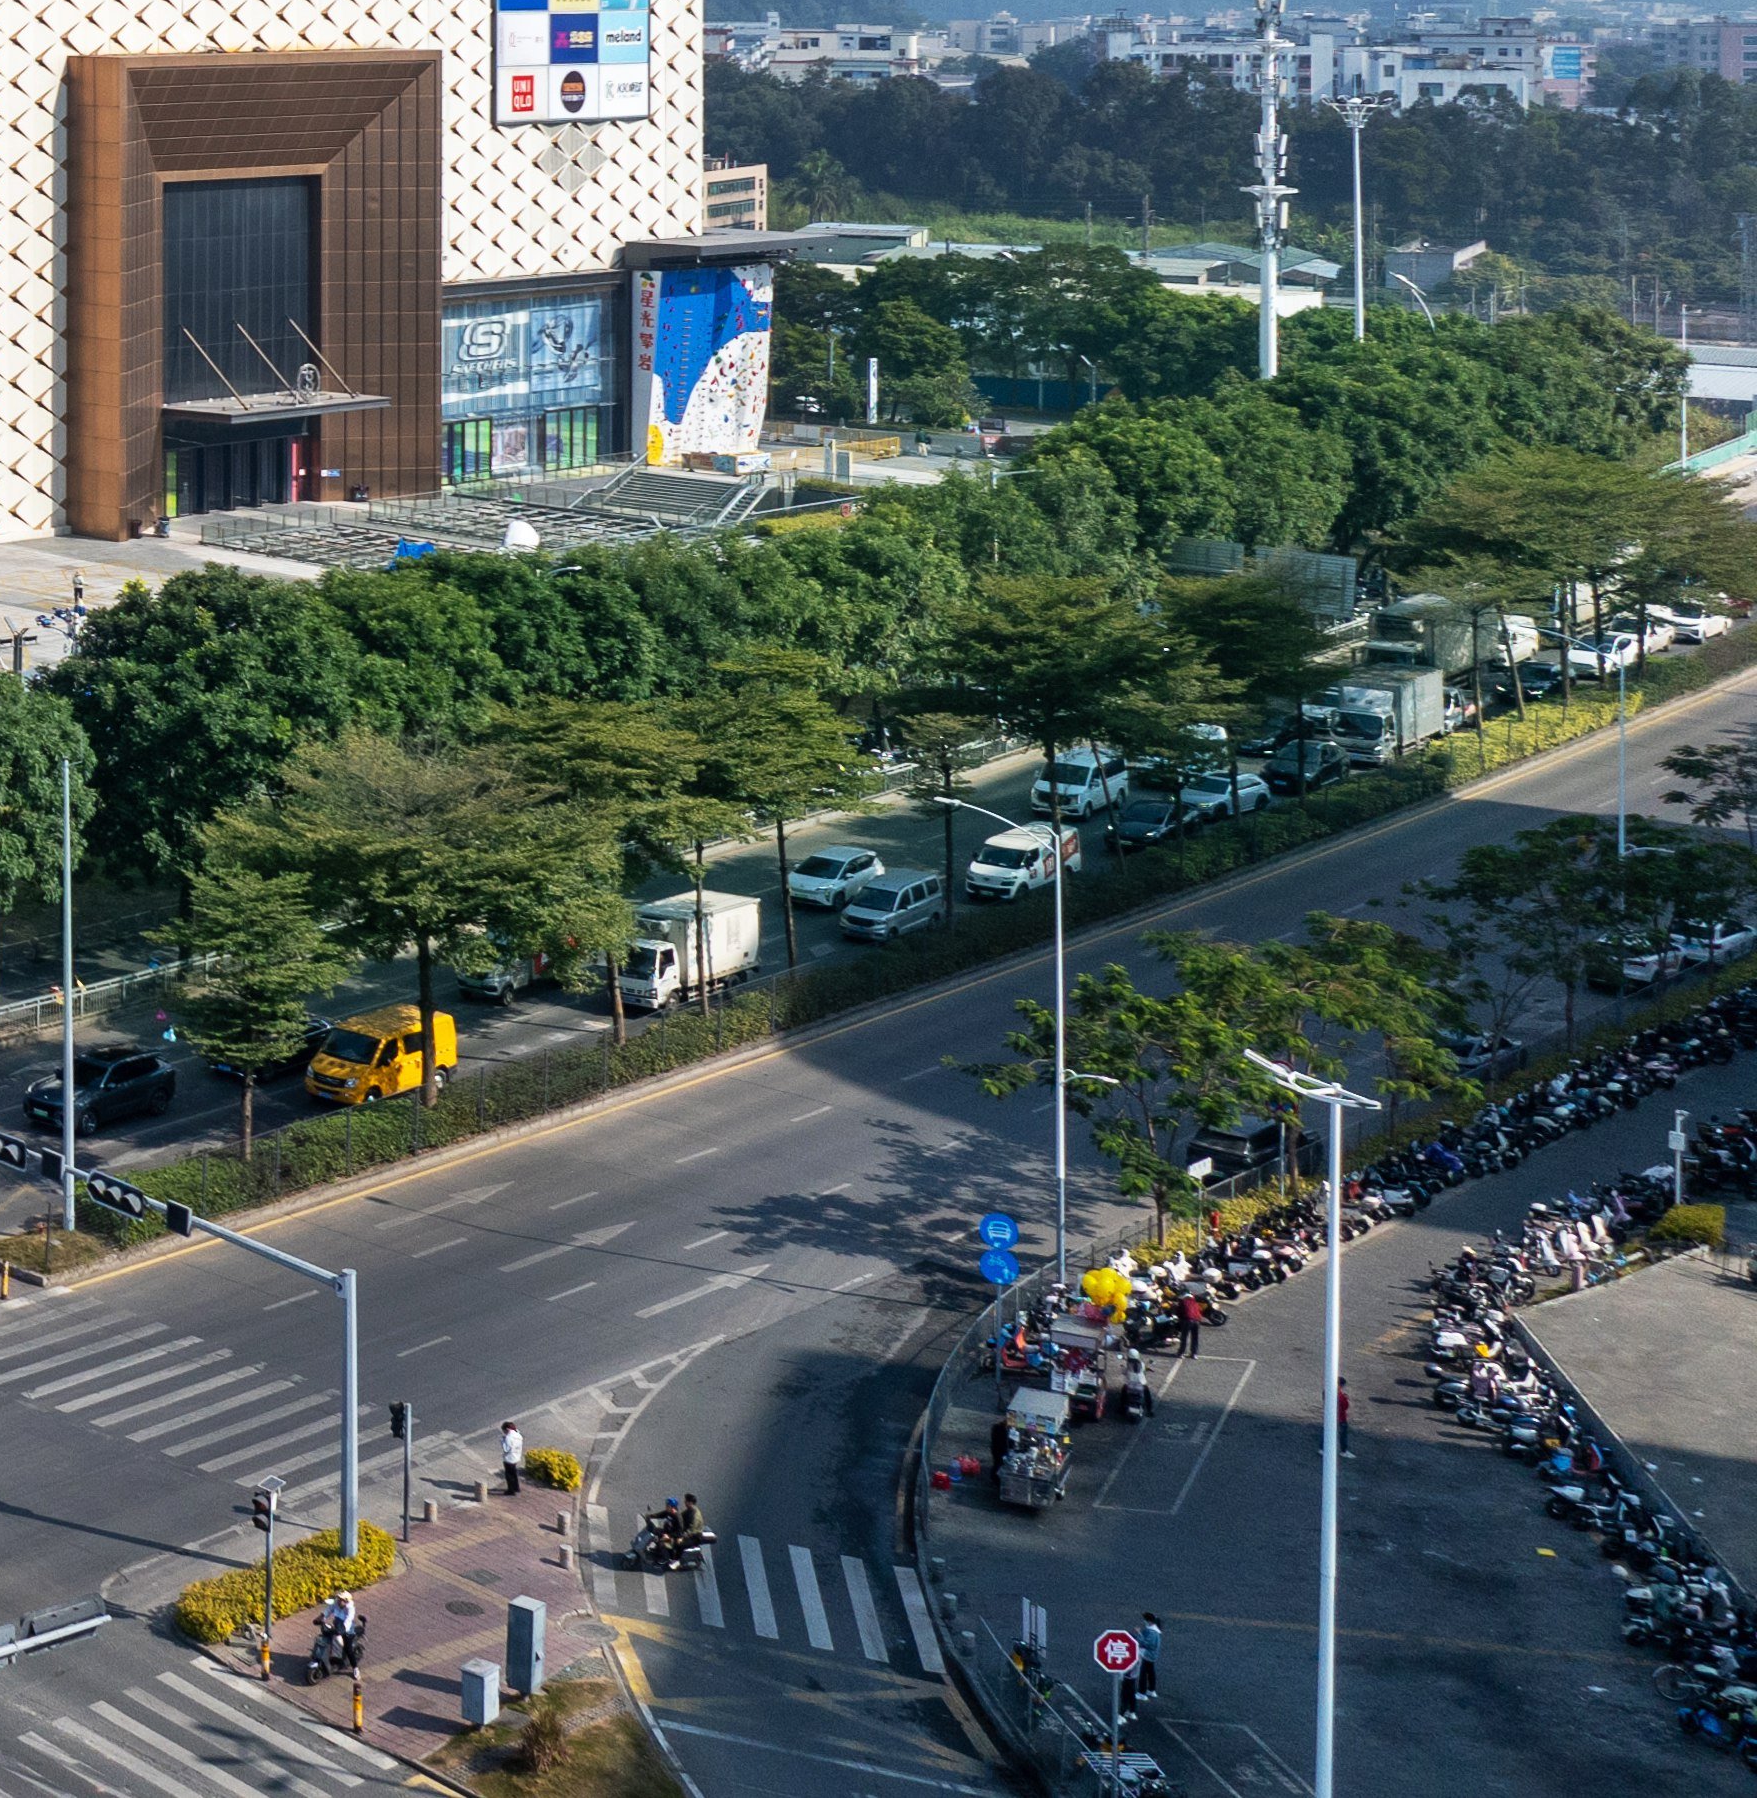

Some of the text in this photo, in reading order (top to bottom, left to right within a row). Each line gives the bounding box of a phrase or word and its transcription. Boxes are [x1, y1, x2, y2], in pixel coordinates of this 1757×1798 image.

[513, 79, 531, 92] UNI
[513, 94, 532, 110] QLO
[1104, 1638, 1130, 1664] 停
